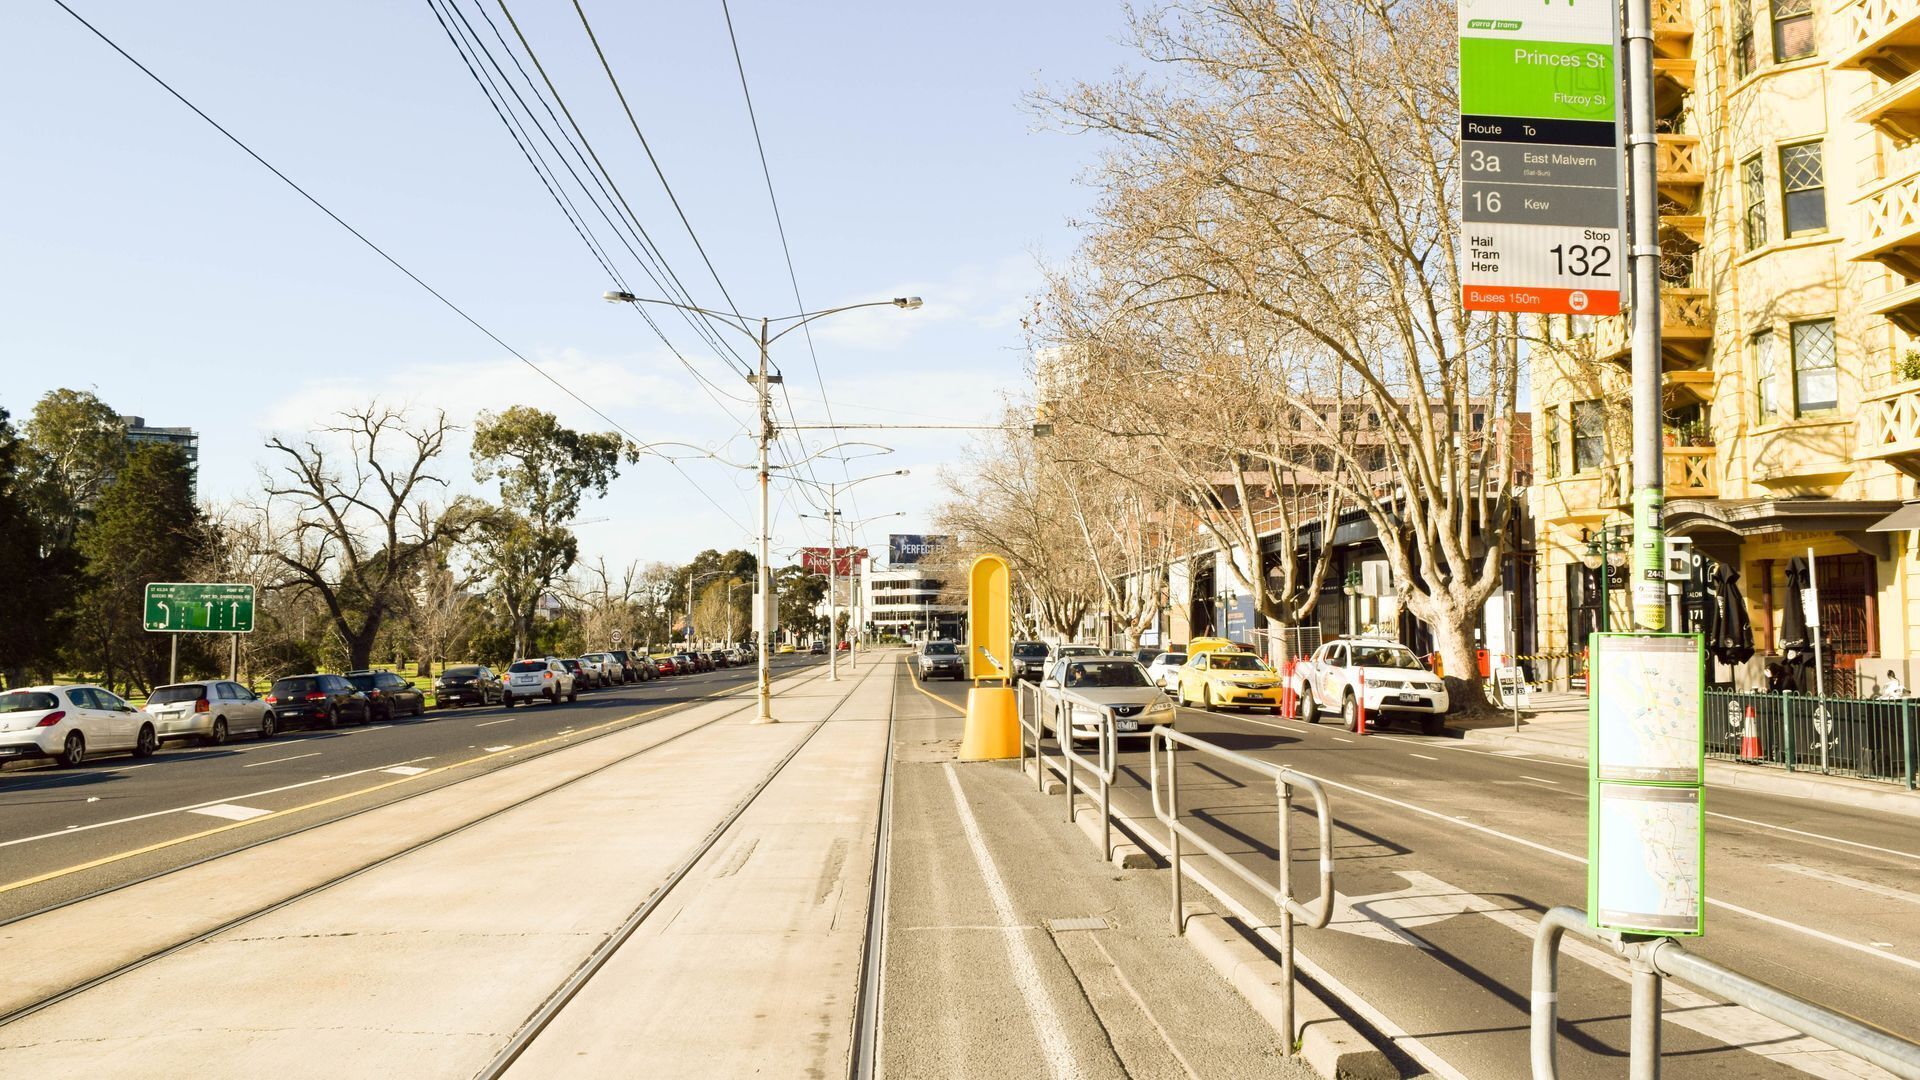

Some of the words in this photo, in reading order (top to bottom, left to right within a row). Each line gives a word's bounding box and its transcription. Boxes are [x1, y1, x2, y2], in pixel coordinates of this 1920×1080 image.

[1514, 49, 1581, 68] Princes
[1586, 52, 1605, 69] St
[1553, 93, 1591, 107] Fitzroy
[1593, 95, 1606, 105] St
[1468, 123, 1502, 135] Route
[1523, 125, 1536, 136] To
[1470, 150, 1501, 172] 3a
[1523, 153, 1549, 165] East
[1551, 154, 1597, 166] Malvern
[1471, 191, 1501, 213] 16
[1524, 199, 1550, 210] Kew
[1470, 236, 1494, 247] Hail
[1583, 230, 1611, 242] Stop
[1470, 248, 1500, 259] Tram
[1470, 261, 1499, 272] Here
[1549, 244, 1611, 277] 132
[1470, 292, 1505, 303] Buses
[1508, 293, 1540, 304] 150m
[901, 544, 934, 554] PERFECT
